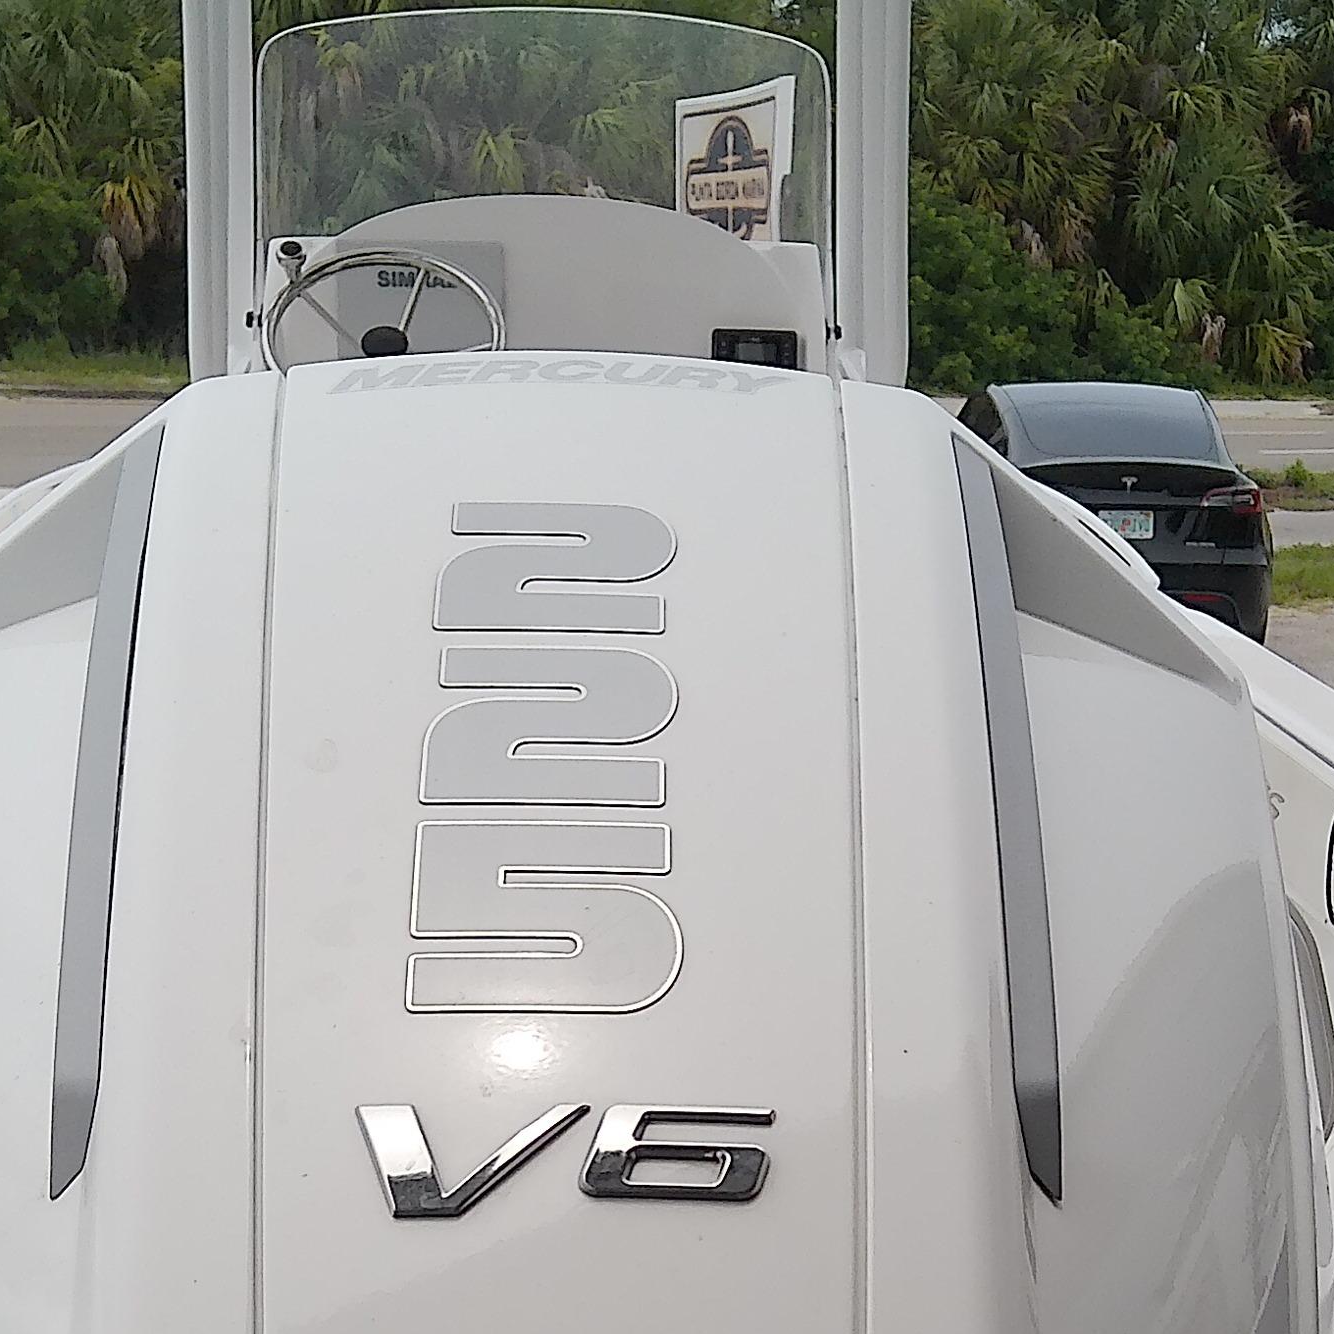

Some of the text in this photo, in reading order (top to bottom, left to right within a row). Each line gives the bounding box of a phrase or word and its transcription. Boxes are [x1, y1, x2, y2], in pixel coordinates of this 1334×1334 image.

[326, 358, 793, 394] MERCURY
[405, 500, 685, 1014] 225
[355, 1102, 777, 1219] V6
